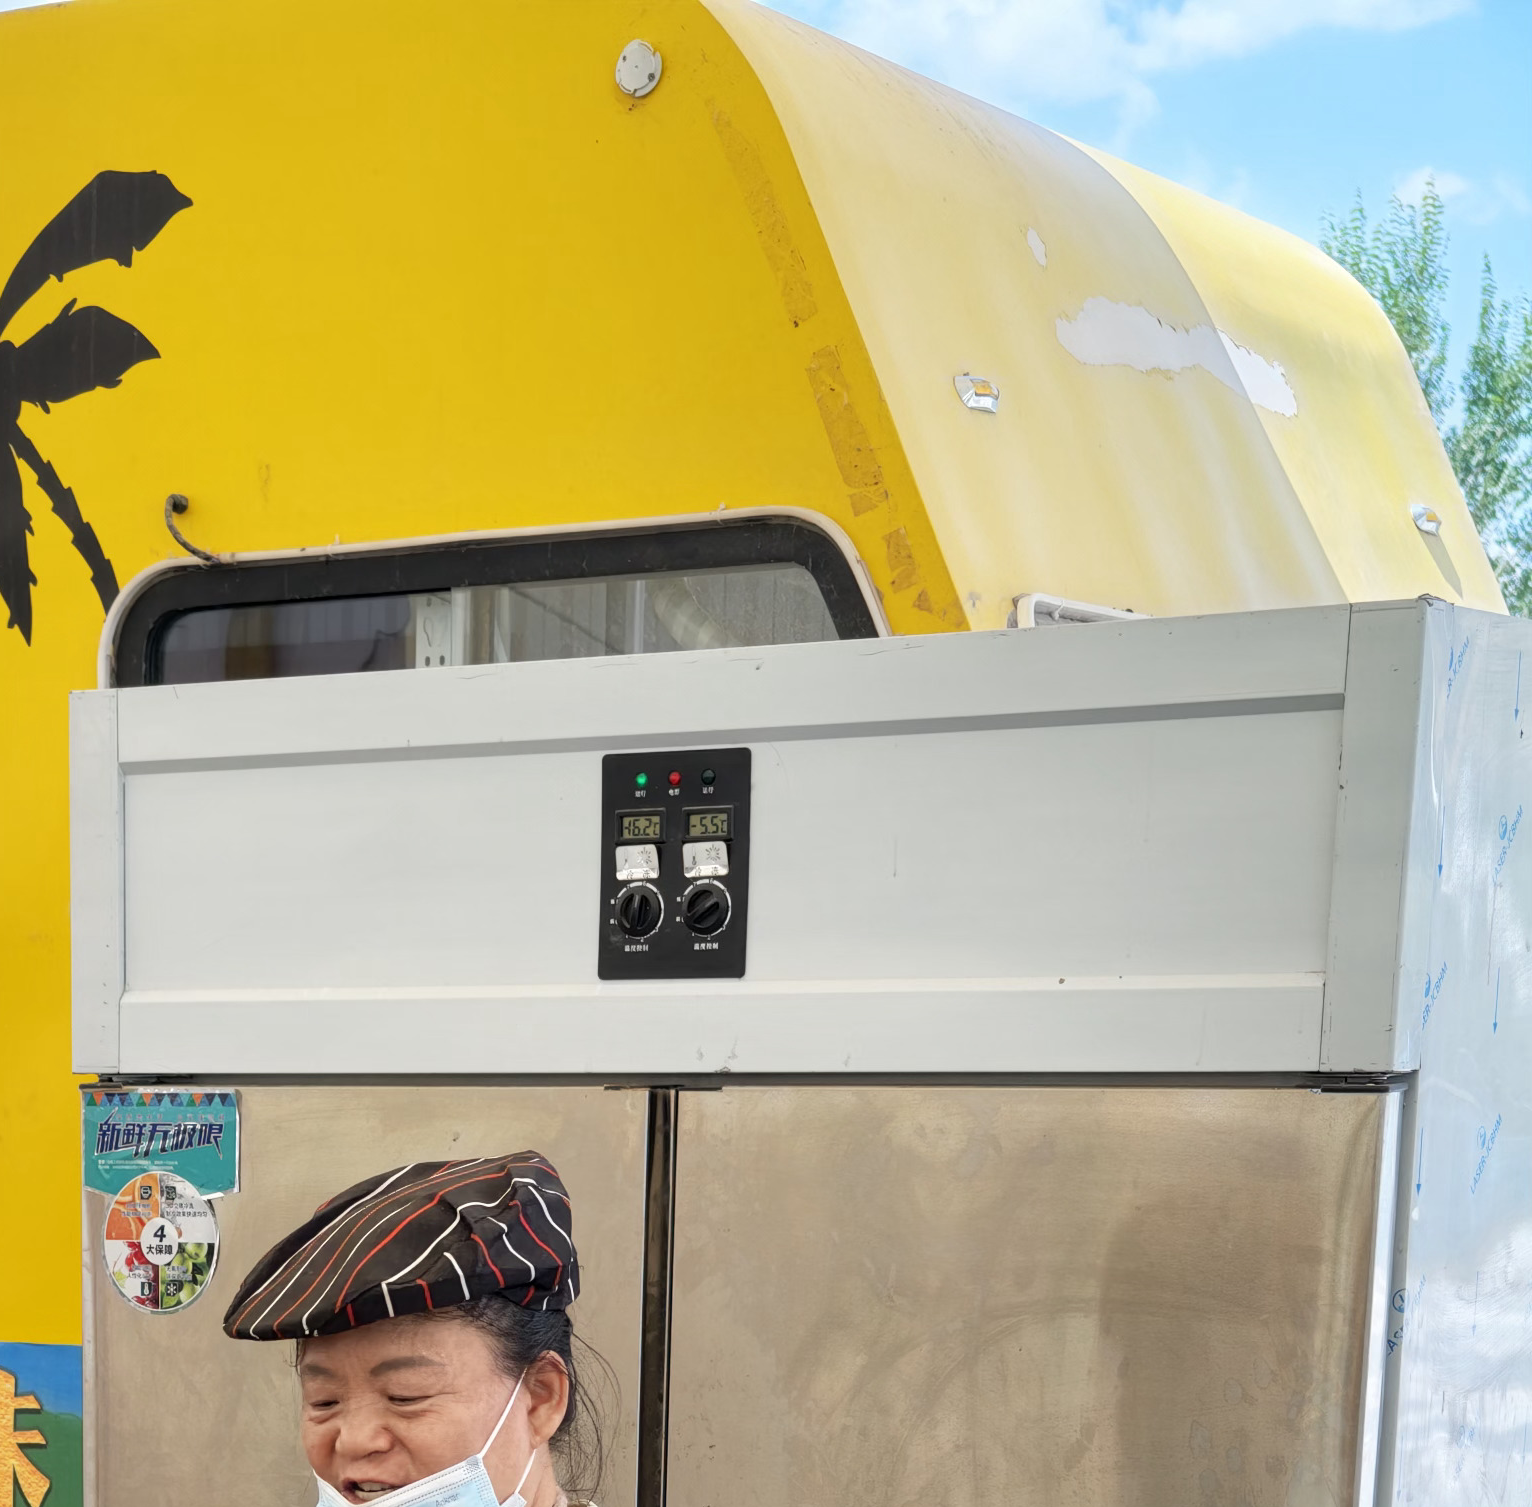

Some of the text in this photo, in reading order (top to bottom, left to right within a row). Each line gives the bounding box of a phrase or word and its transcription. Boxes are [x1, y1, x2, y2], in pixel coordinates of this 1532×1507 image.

[95, 1107, 225, 1160] 新鲜无极限
[153, 1224, 167, 1243] 4
[146, 1244, 173, 1256] 大保障
